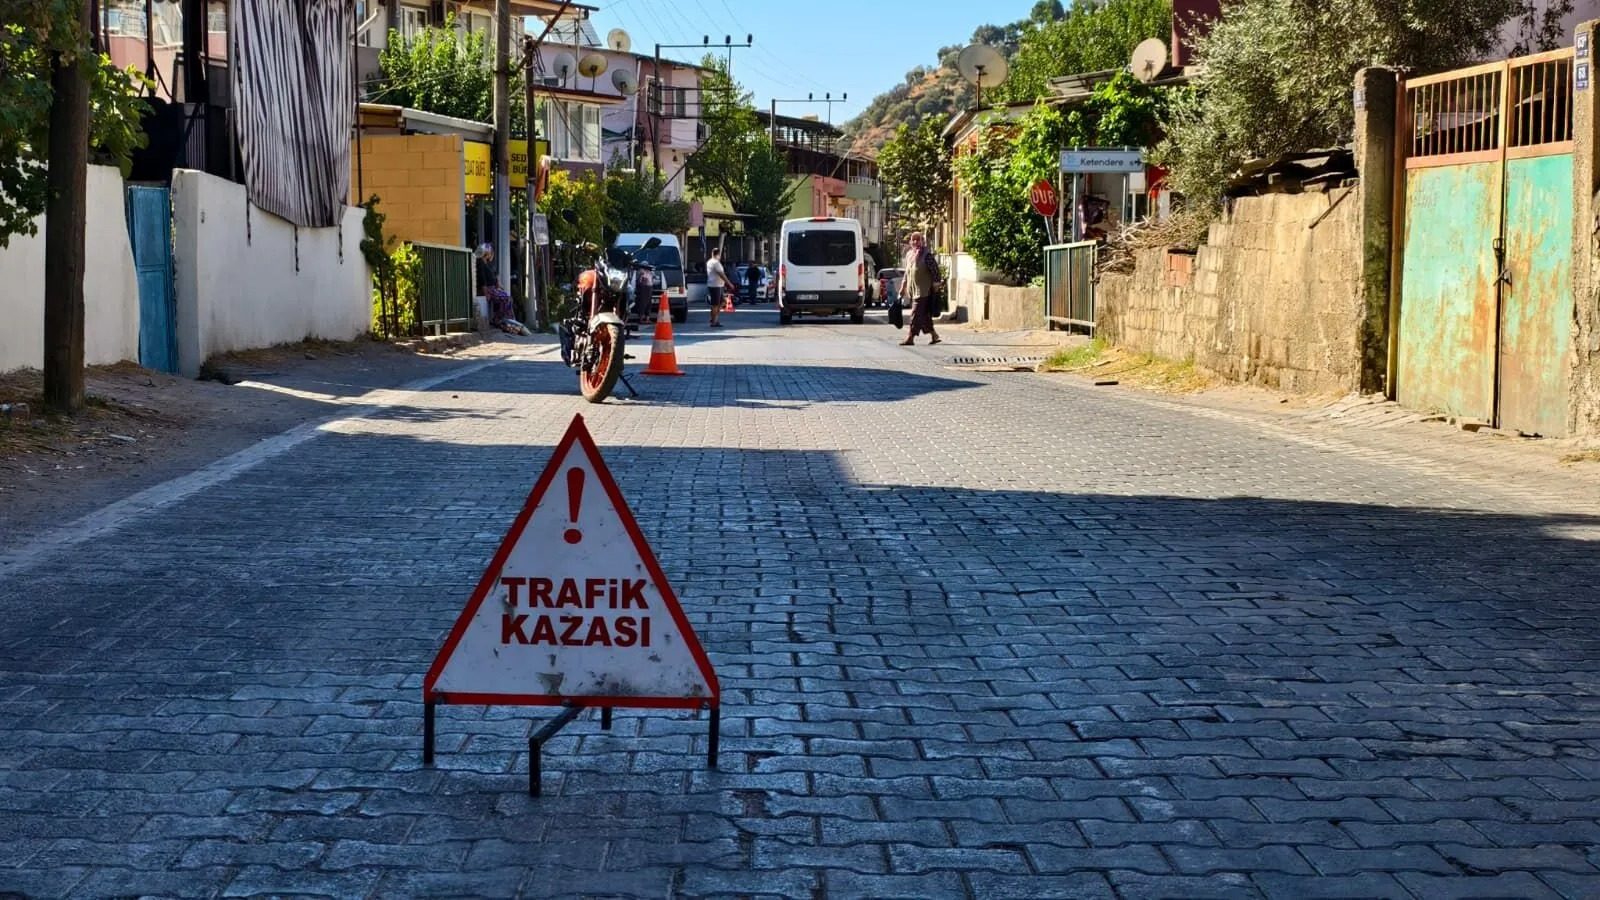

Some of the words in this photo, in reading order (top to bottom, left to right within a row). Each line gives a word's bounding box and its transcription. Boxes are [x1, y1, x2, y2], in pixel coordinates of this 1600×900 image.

[1080, 158, 1124, 167] Ketendere
[1032, 187, 1056, 205] DUR
[501, 614, 650, 647] KAZASI
